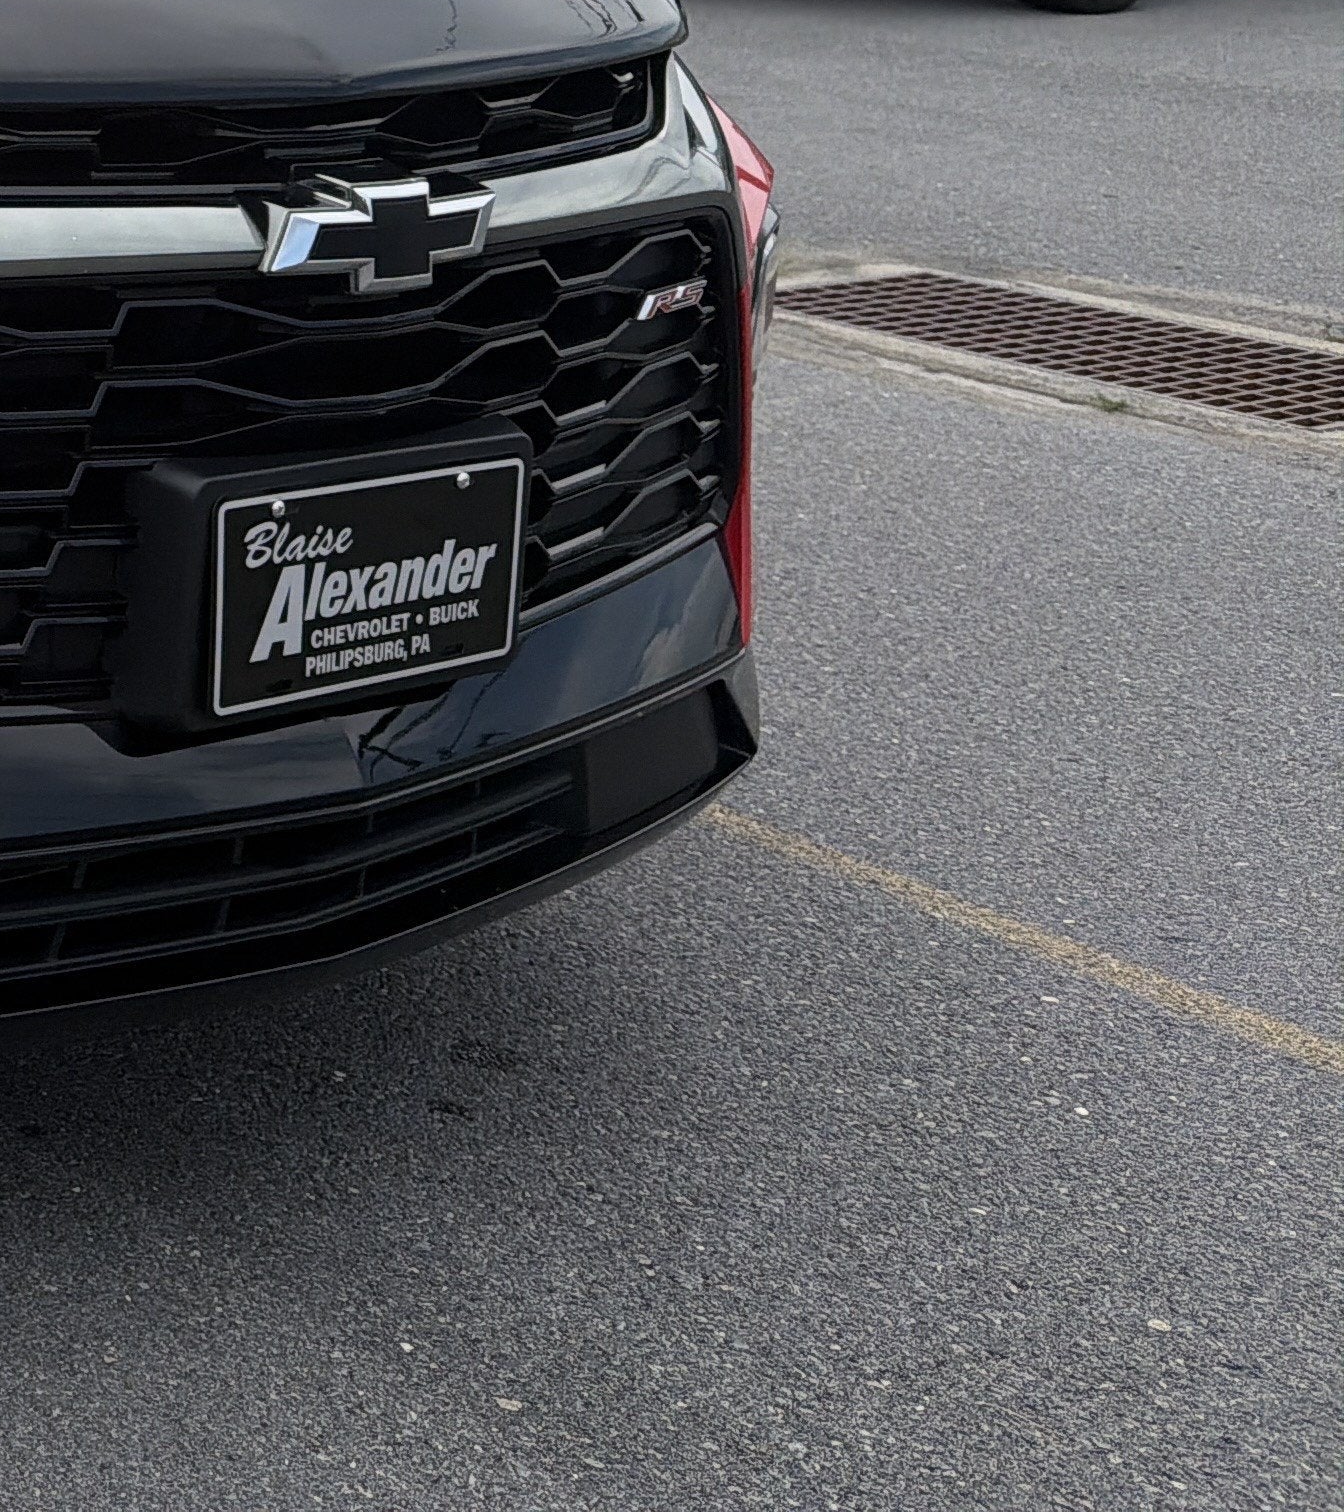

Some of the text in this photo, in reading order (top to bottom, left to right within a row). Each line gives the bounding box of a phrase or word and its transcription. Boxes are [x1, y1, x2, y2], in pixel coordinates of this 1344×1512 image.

[636, 278, 709, 321] RS
[243, 521, 353, 569] Blaise
[249, 538, 498, 664] Alexander
[310, 599, 480, 649] CHEVROLET BUICK
[305, 633, 431, 678] PHILIPSBURG, PA
